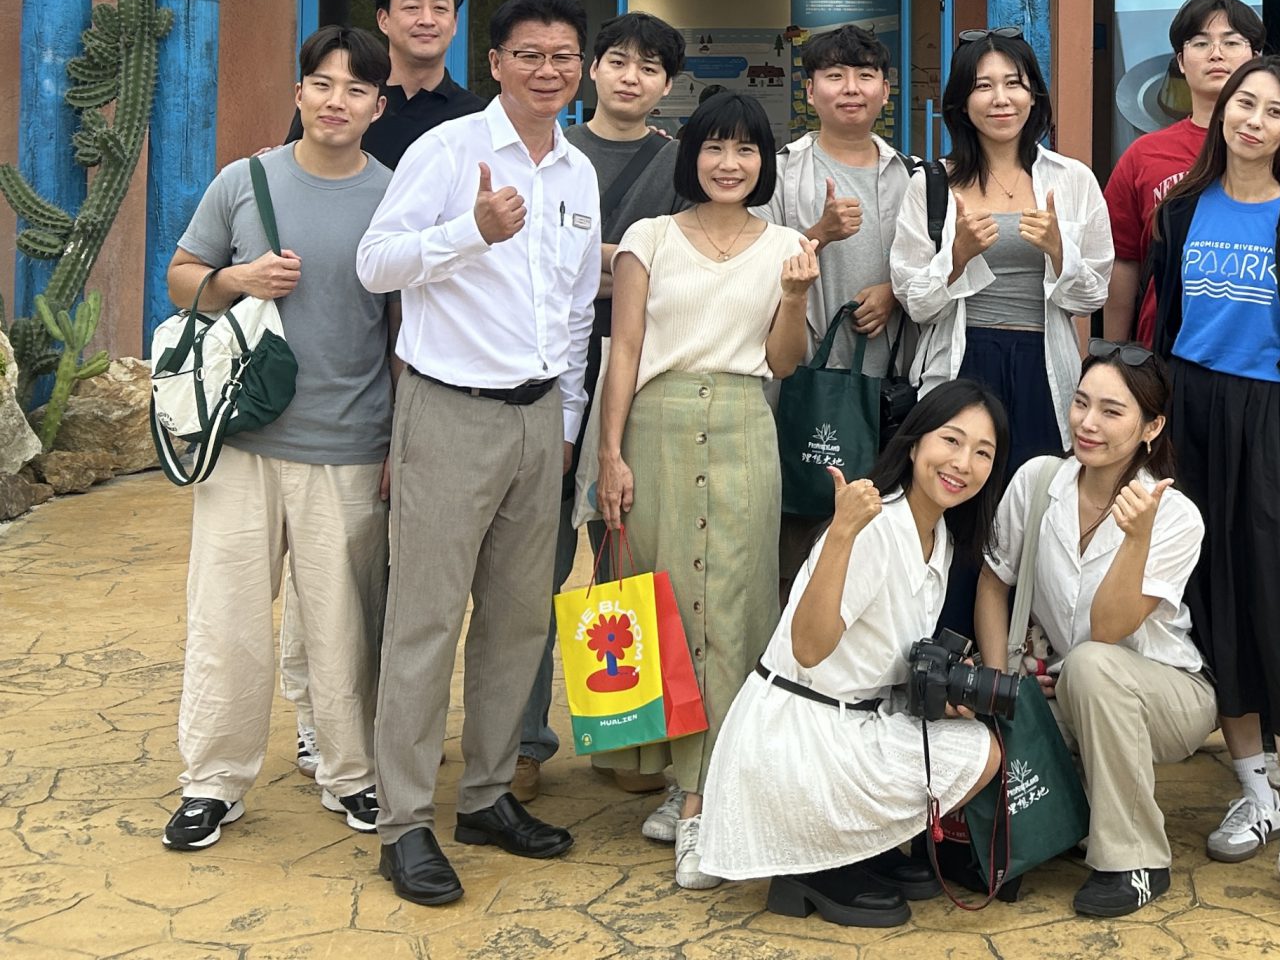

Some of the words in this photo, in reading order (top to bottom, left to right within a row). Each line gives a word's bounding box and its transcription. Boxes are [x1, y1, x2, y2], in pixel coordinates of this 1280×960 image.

[1190, 241, 1231, 249] PROMISED
[1233, 243, 1275, 255] RIVERWA
[575, 608, 596, 641] WE
[600, 713, 638, 727] HUALIEN
